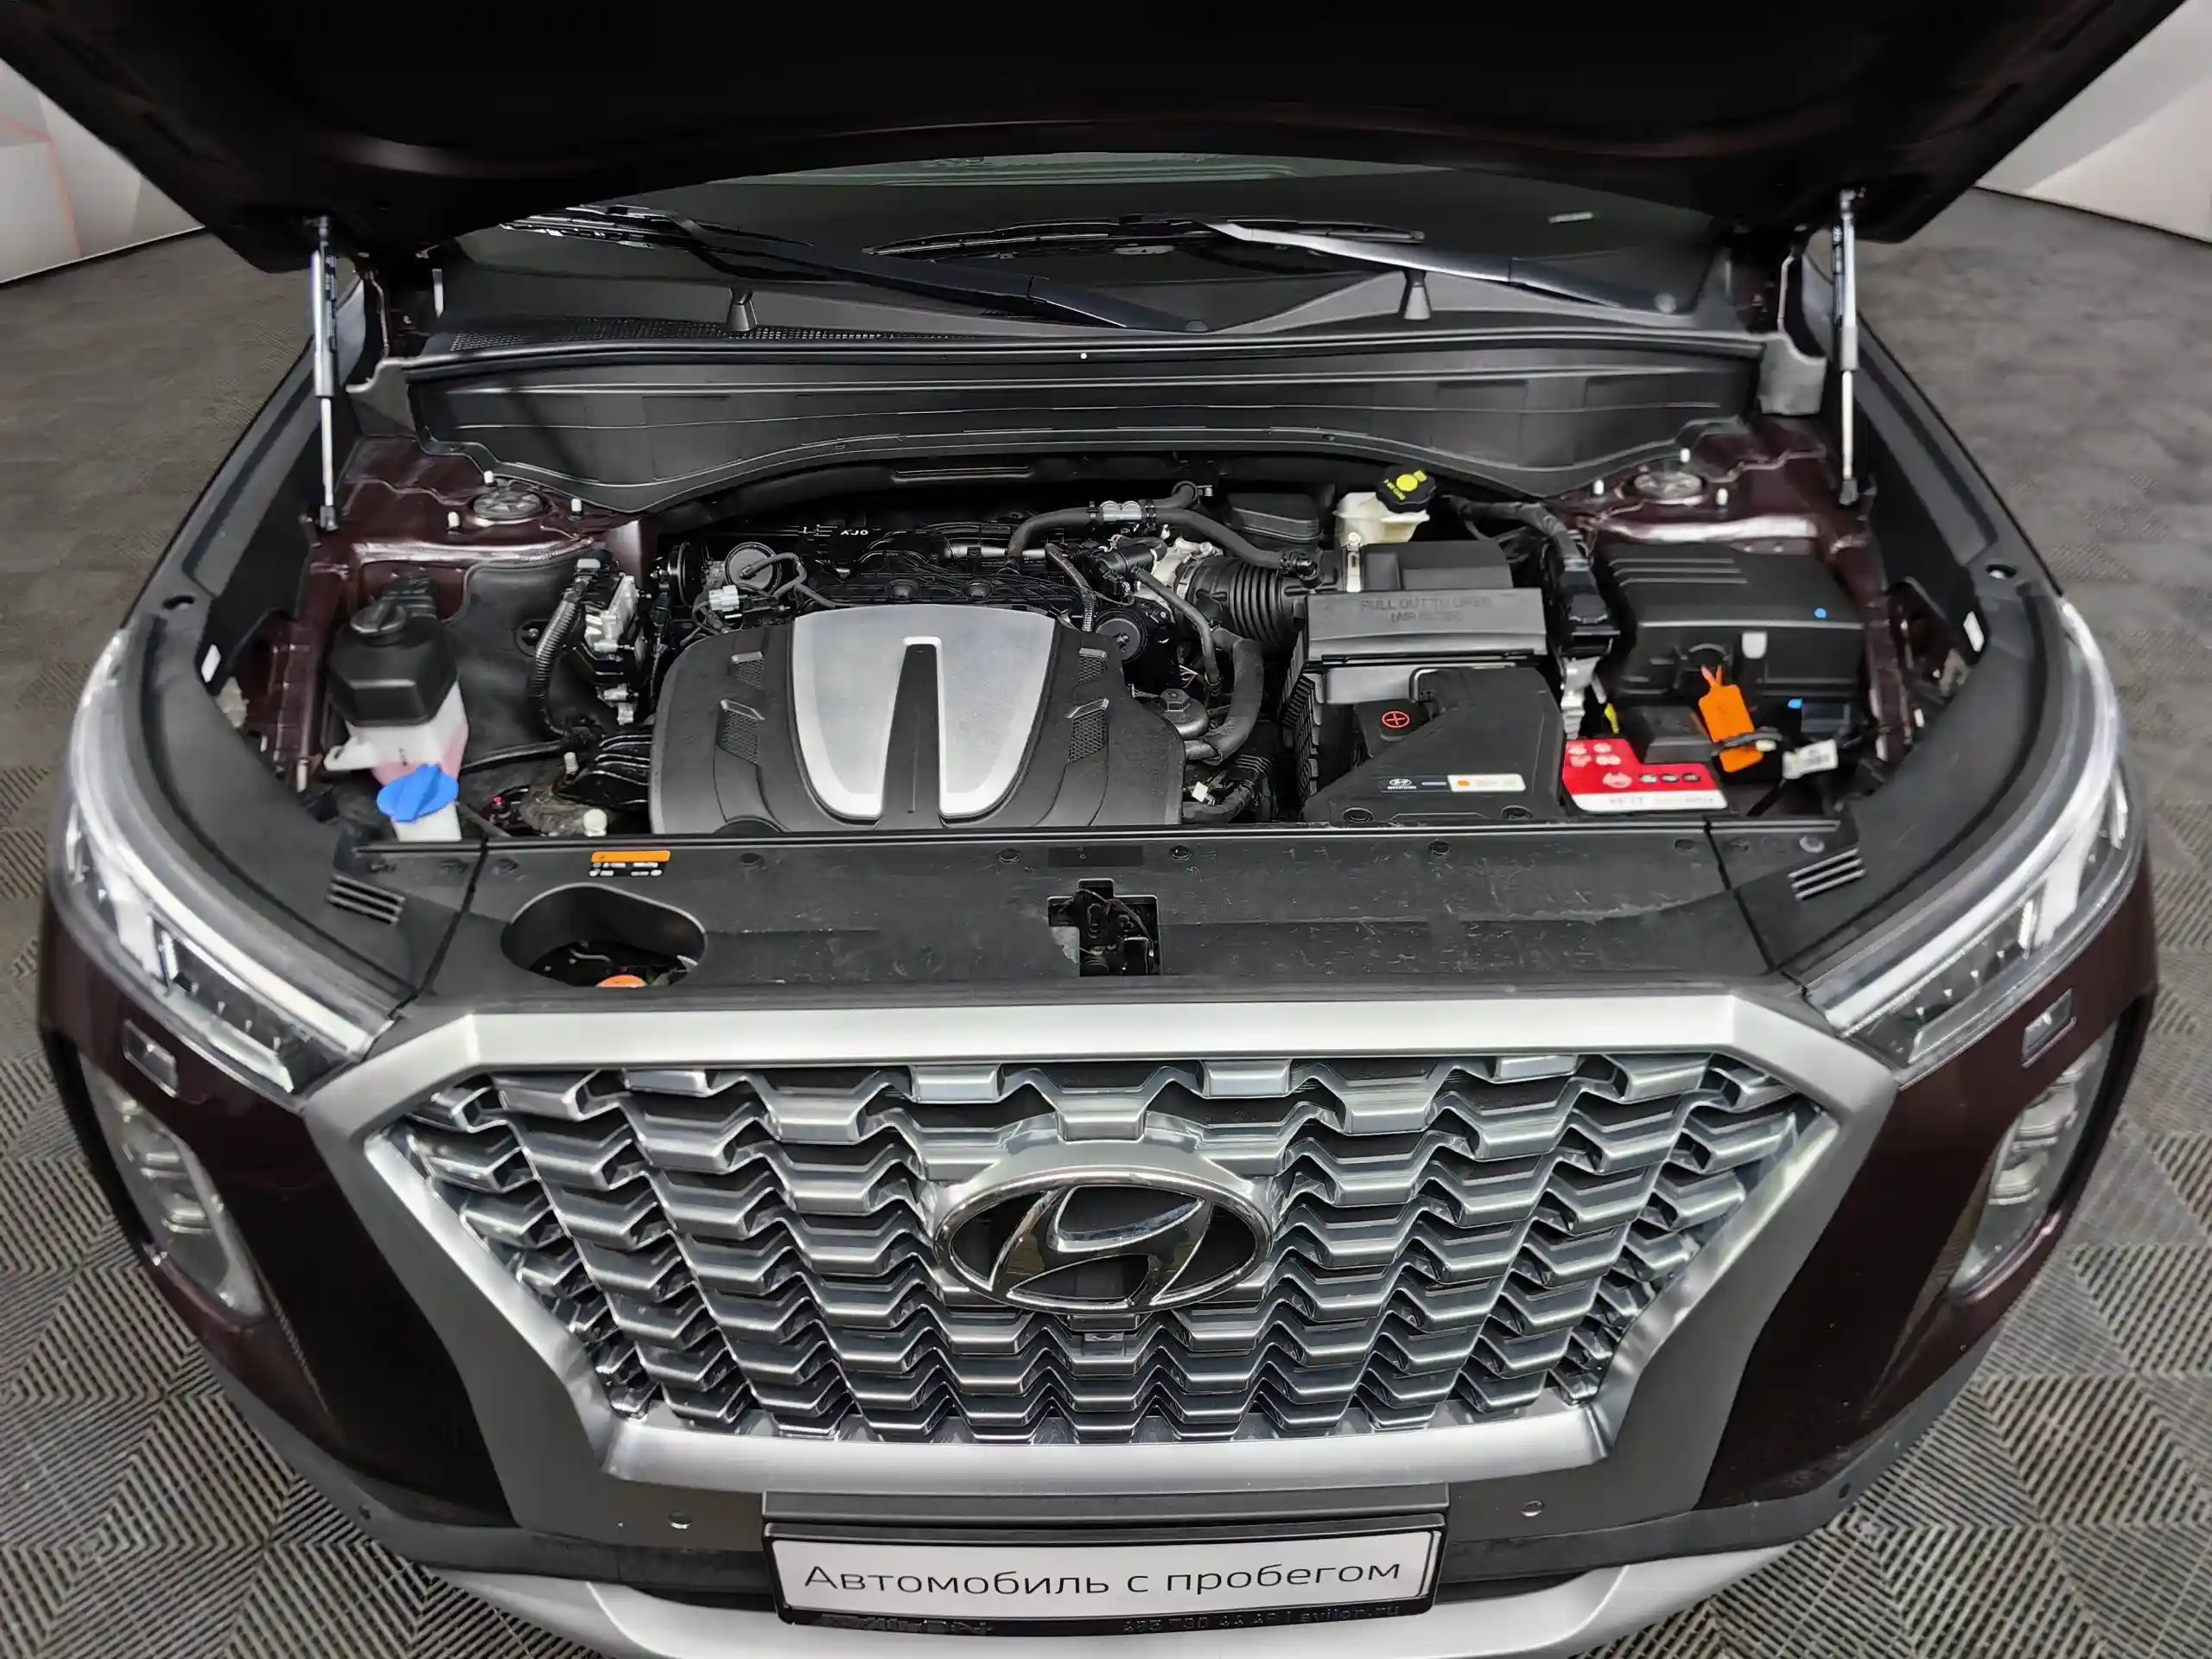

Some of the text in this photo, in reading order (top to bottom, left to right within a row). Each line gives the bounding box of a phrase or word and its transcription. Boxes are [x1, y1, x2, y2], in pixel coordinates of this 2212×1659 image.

[804, 1563, 1401, 1595] Автомобиль с пробегом
